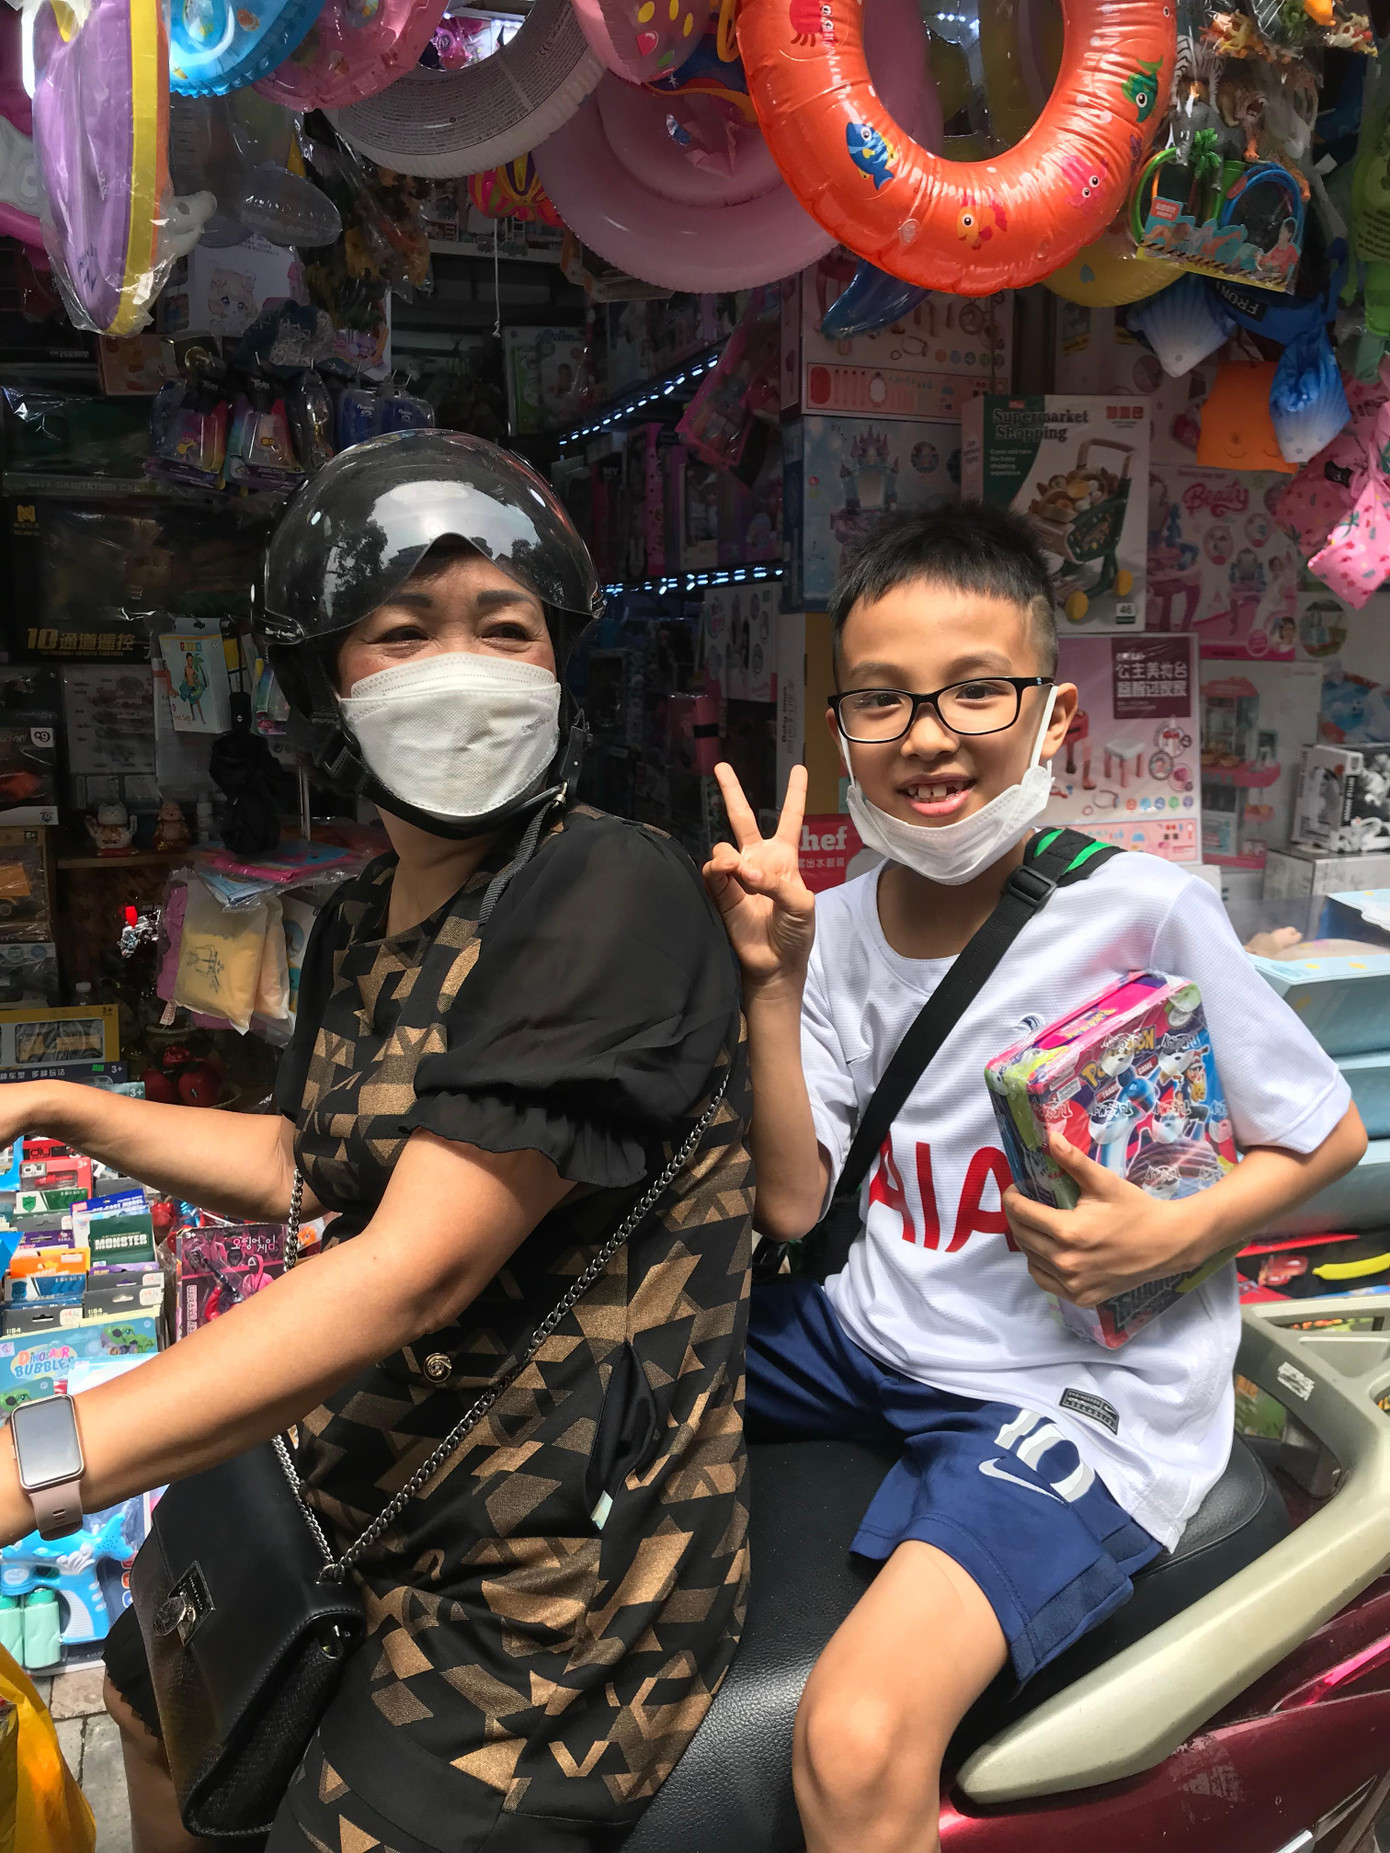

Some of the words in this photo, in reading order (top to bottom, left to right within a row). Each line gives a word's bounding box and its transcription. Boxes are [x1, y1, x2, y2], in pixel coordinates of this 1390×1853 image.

[992, 408, 1089, 427] Supermarket
[995, 424, 1068, 443] Shopping
[800, 825, 848, 851] hef
[111, 1065, 122, 1074] 3+
[130, 1088, 143, 1097] 3+
[77, 1160, 88, 1169] 3+
[869, 1131, 1024, 1252] AIA
[95, 1234, 148, 1250] MONSTER
[231, 1235, 261, 1250] 오징어
[257, 1235, 276, 1253] 게임
[18, 1346, 70, 1366] DINOSAUR
[994, 1408, 1096, 1503] 10
